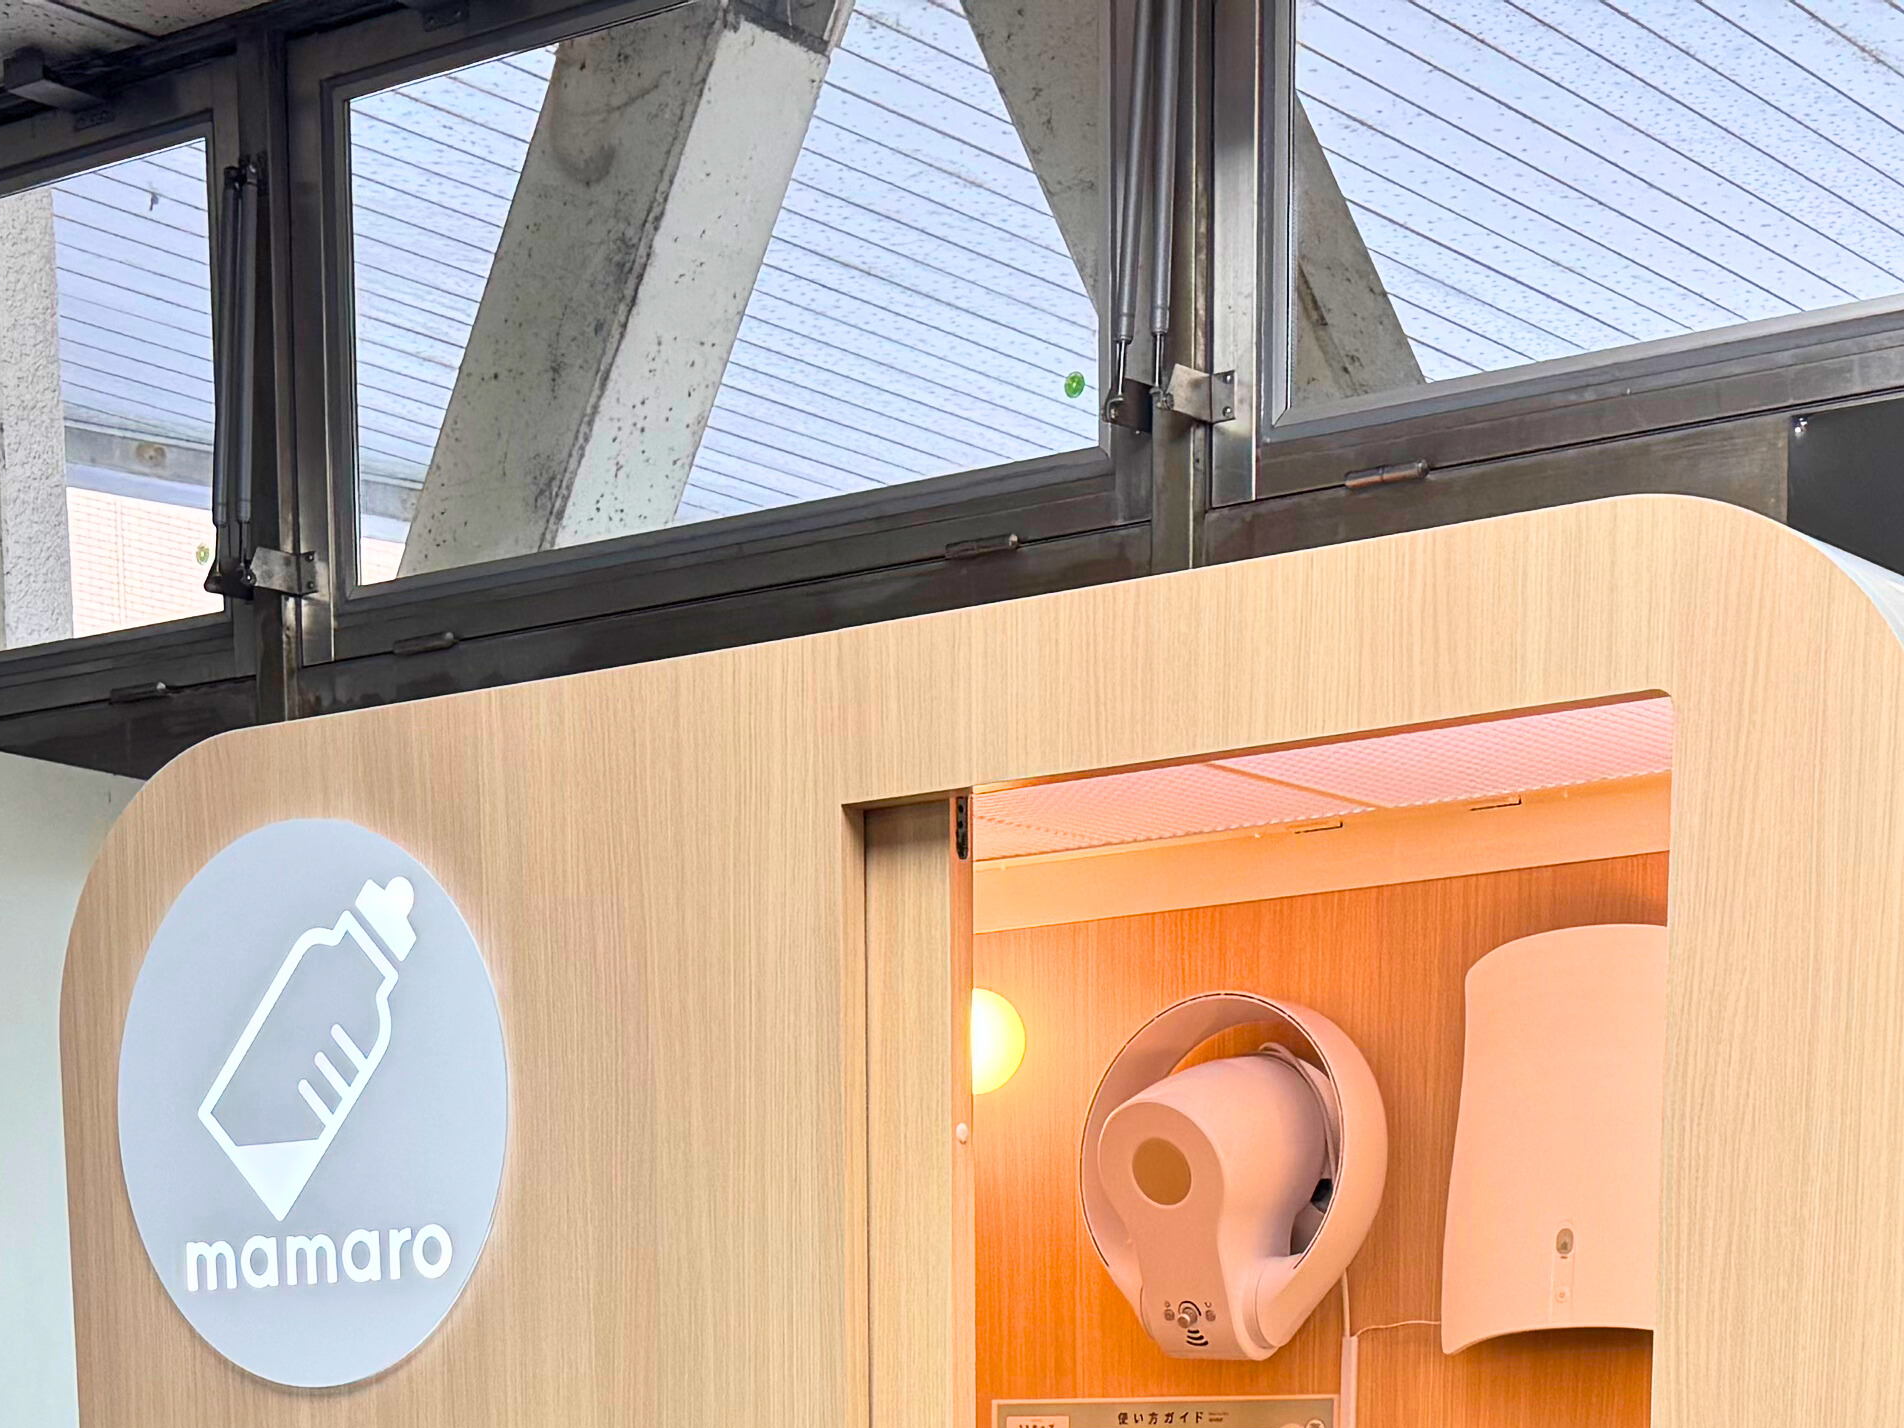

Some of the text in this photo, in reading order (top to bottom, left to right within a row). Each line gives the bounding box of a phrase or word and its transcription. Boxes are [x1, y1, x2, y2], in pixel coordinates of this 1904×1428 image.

[185, 1222, 453, 1292] mamaro
[1118, 1410, 1204, 1426] 使い方ガイド
